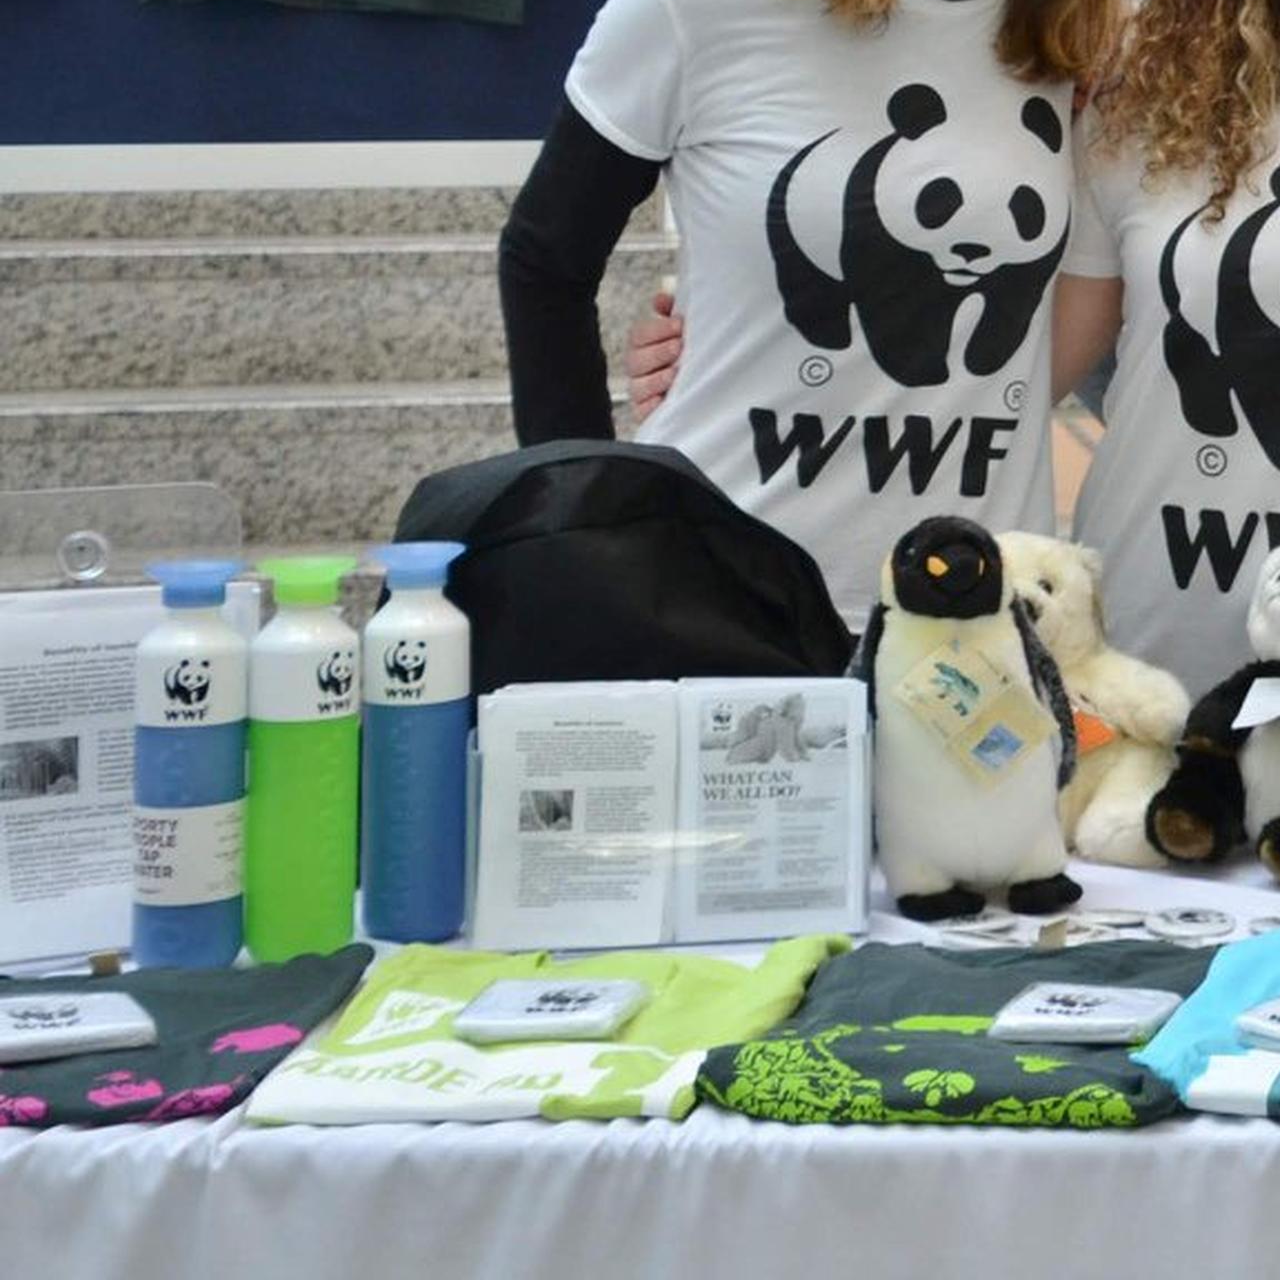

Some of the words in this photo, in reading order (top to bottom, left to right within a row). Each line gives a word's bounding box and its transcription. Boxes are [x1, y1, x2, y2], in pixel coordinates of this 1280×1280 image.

[748, 406, 1019, 498] WWF
[384, 684, 425, 700] WWF
[164, 706, 209, 721] WWF
[702, 770, 757, 786] WHAT
[758, 769, 794, 784] CAN
[702, 786, 731, 801] WE
[734, 785, 767, 800] ALL
